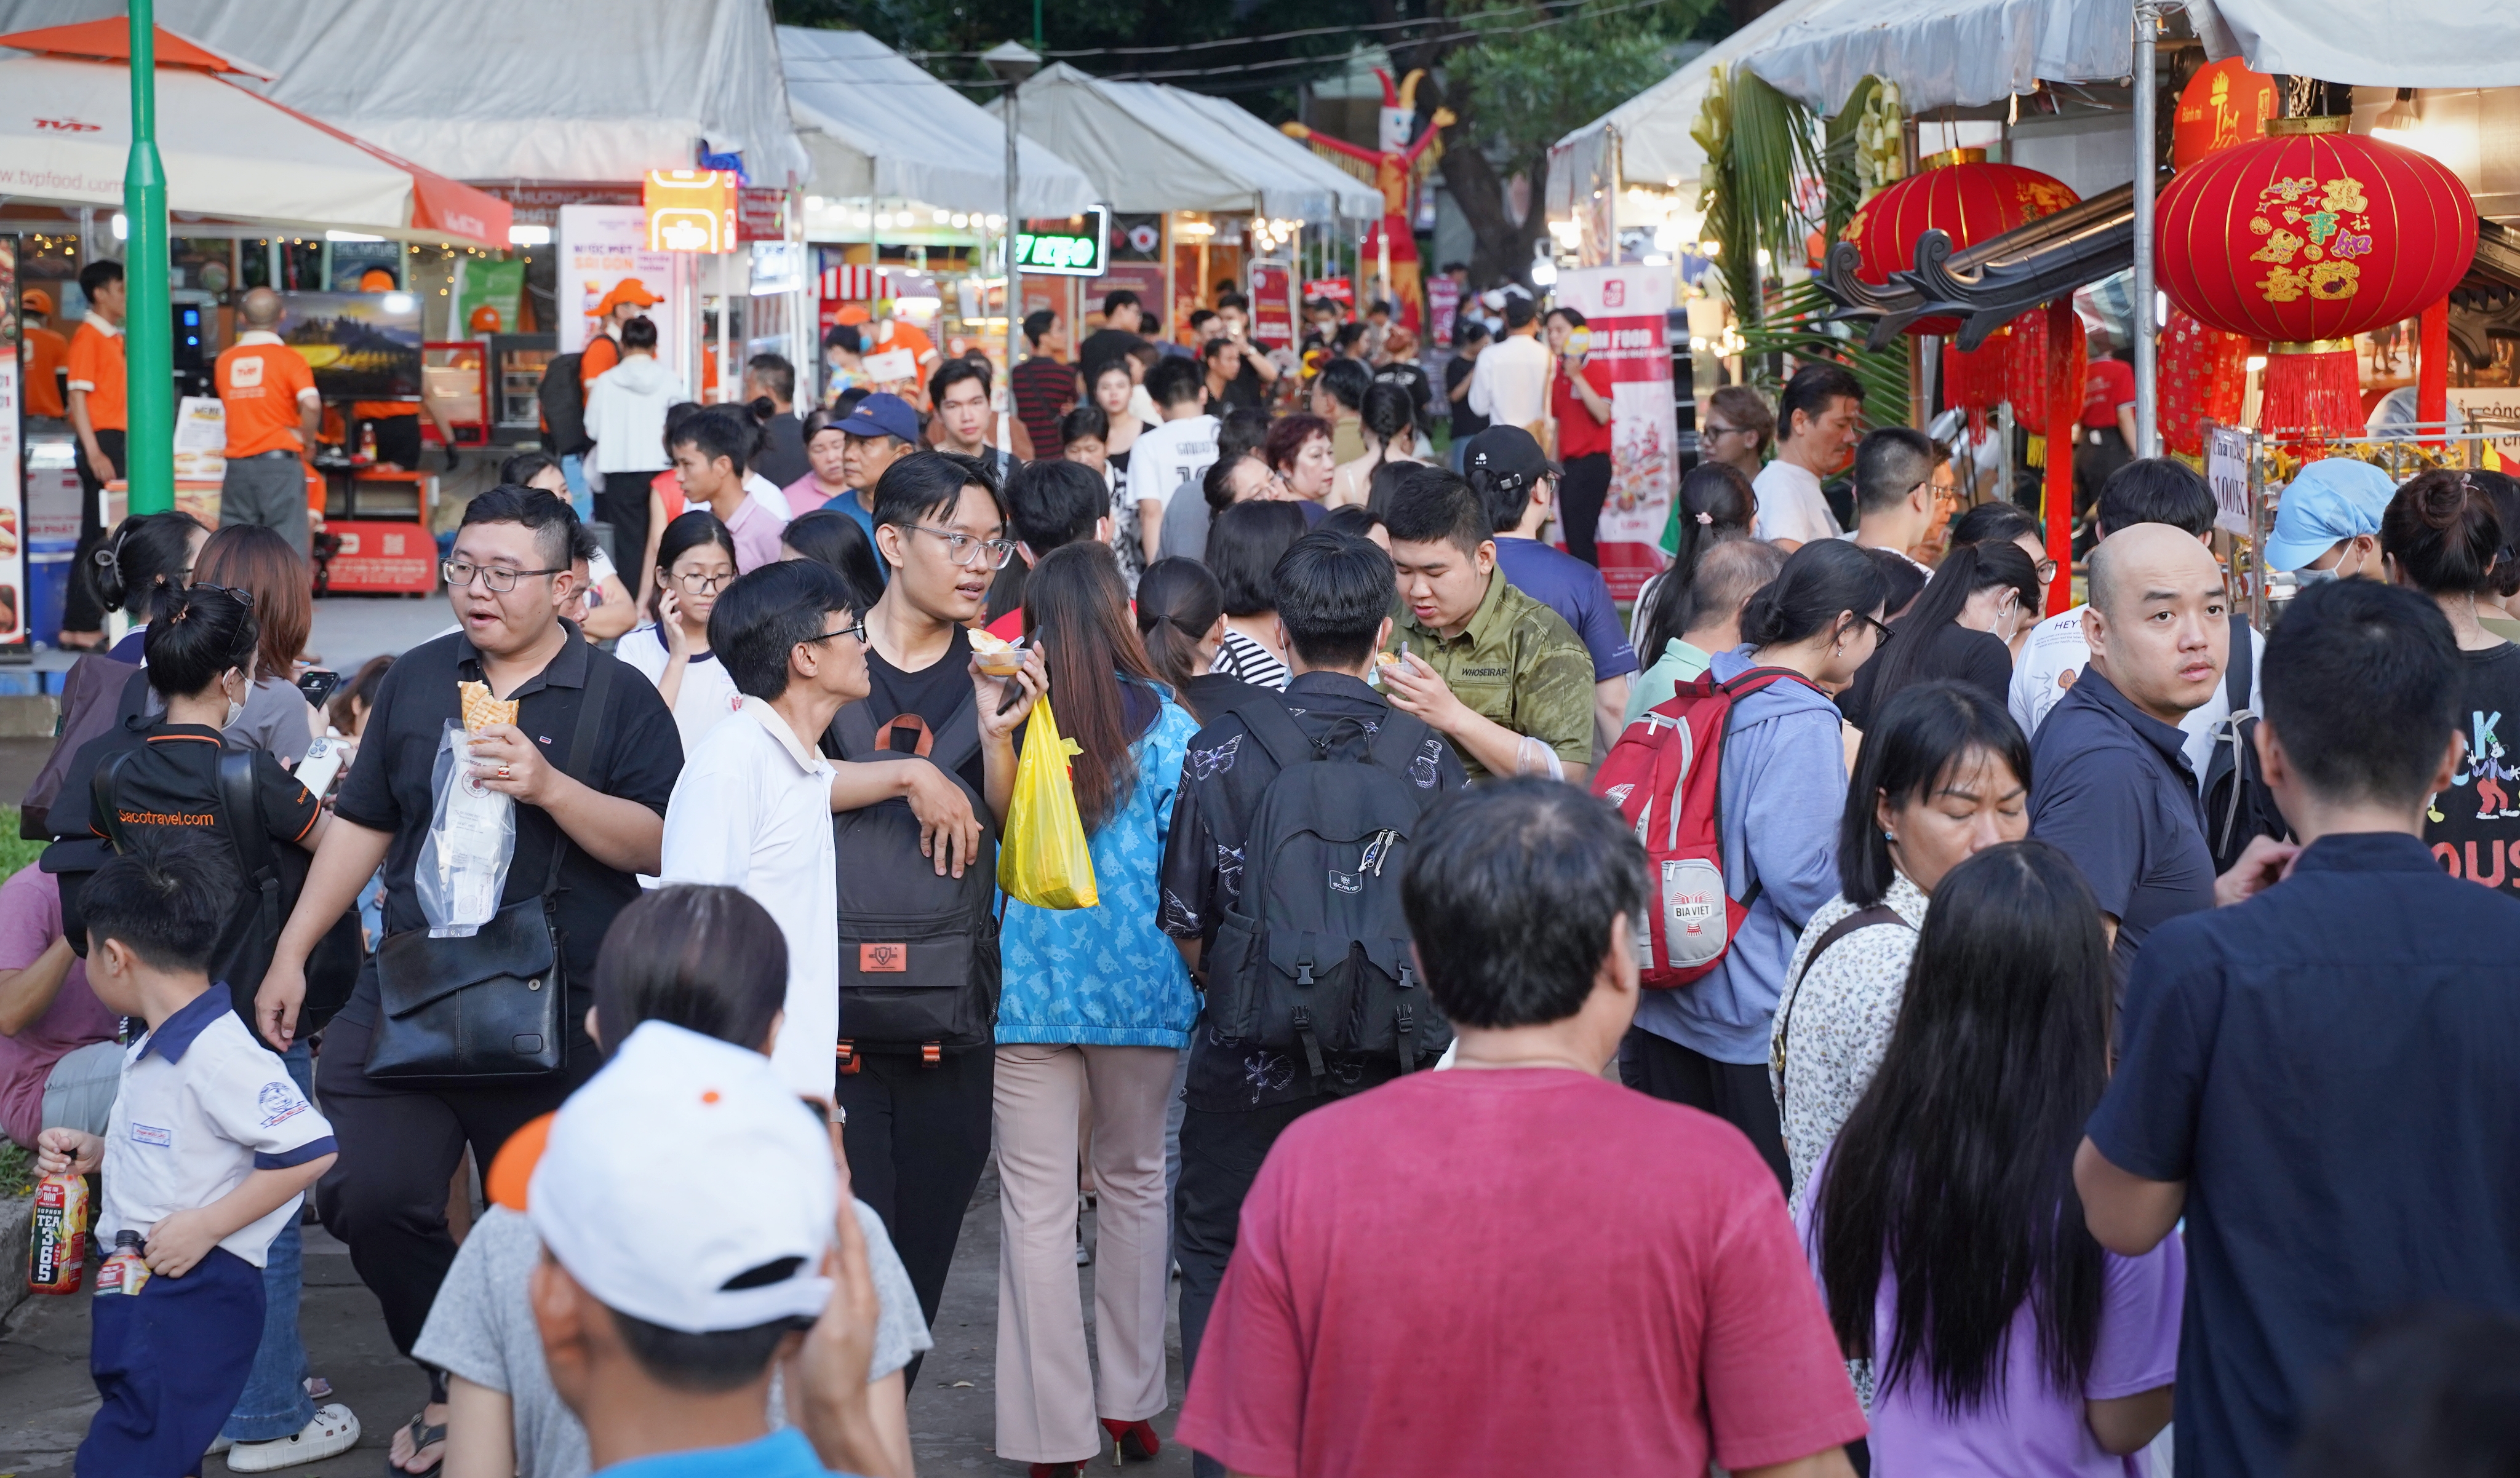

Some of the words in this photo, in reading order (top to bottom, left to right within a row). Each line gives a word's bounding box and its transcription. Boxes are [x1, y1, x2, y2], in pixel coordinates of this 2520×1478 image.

[2215, 475, 2246, 510] 100K
[119, 810, 214, 825] Sacotravel.com
[1676, 907, 1691, 916] BIA
[1691, 904, 1710, 917] VIỆT
[37, 1215, 60, 1228] TEA
